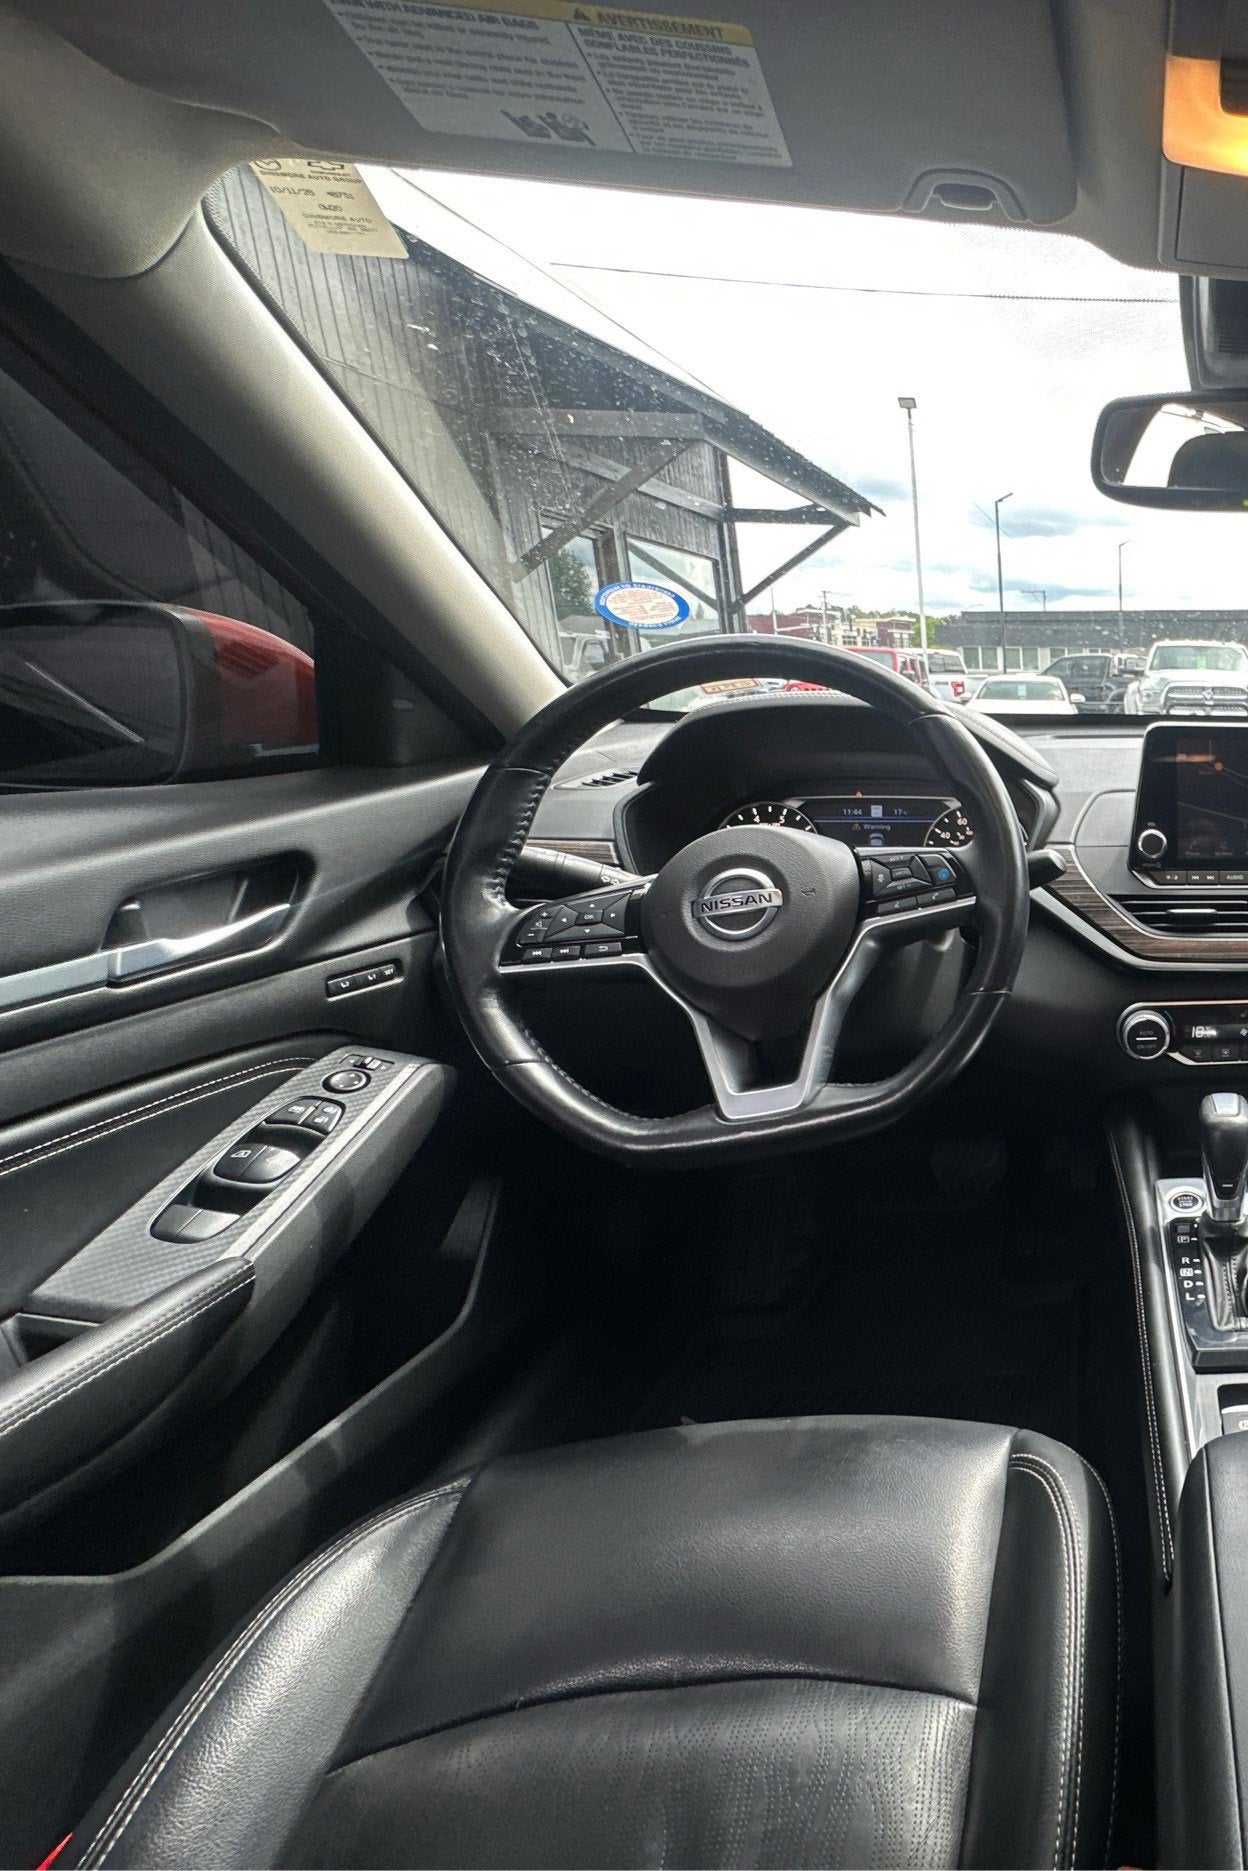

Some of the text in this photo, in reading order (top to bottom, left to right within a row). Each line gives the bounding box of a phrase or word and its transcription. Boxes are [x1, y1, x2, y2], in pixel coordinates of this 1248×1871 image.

[596, 11, 725, 39] AVERTISSEMENT
[618, 33, 649, 45] AVEC
[650, 37, 674, 48] DES
[308, 174, 331, 182] AUTO
[753, 815, 760, 823] 4
[779, 815, 785, 824] 5
[957, 817, 968, 826] 60
[940, 831, 951, 840] 40
[701, 893, 772, 913] NISSAN
[1181, 1256, 1190, 1265] R
[1183, 1280, 1194, 1289] D
[1185, 1292, 1196, 1301] L
